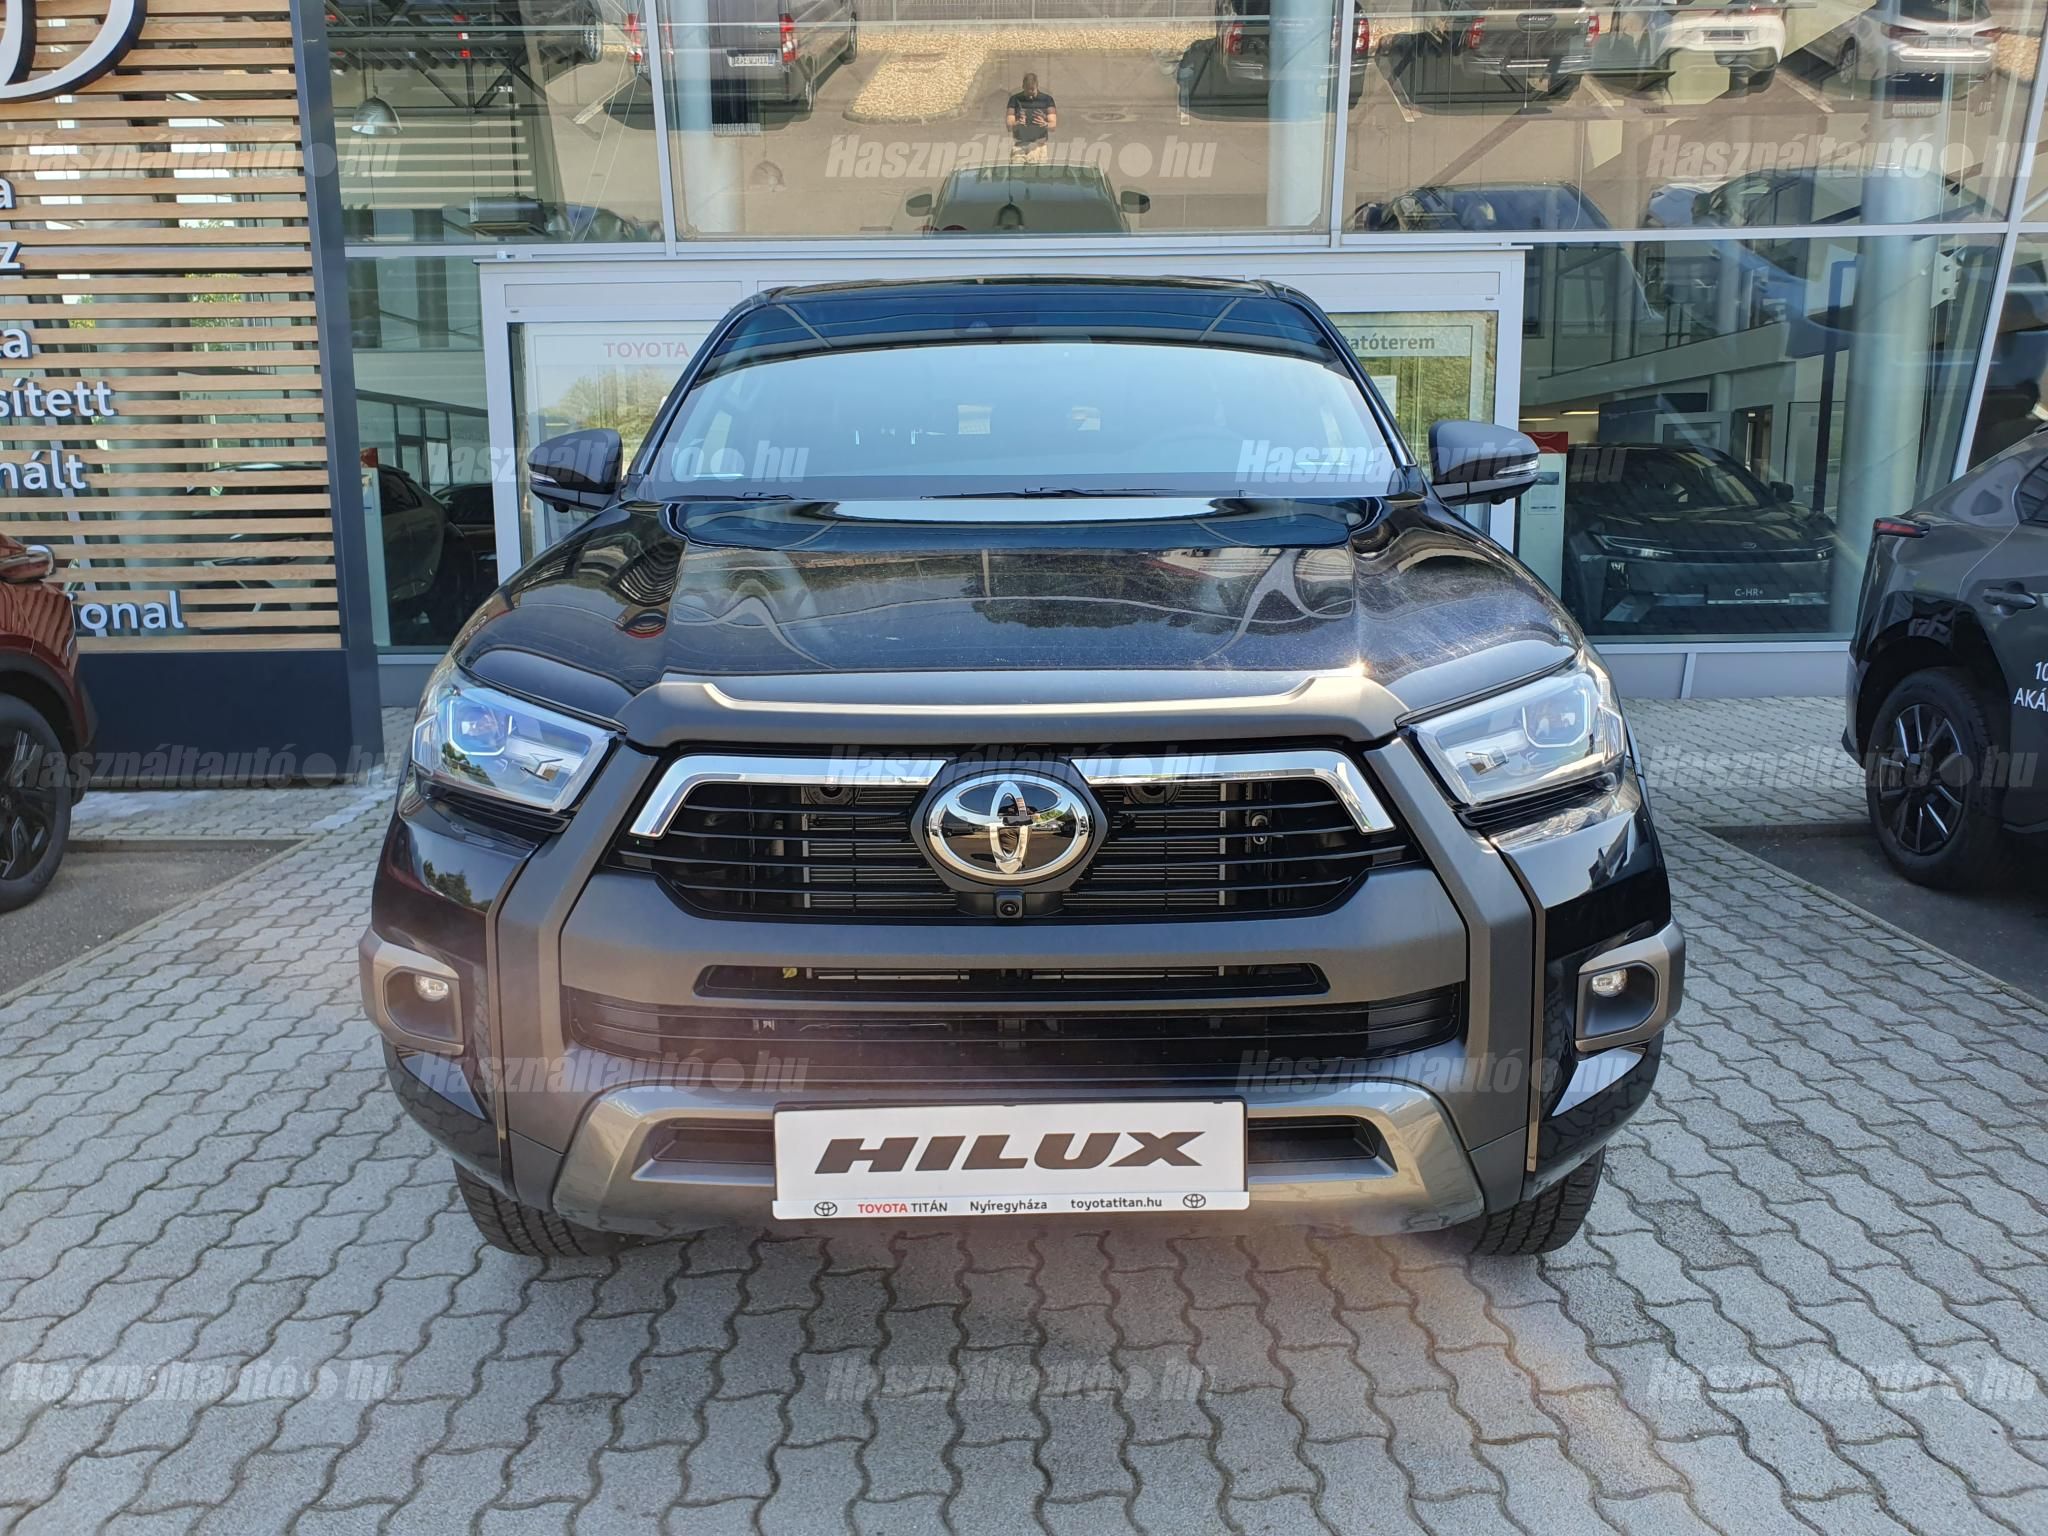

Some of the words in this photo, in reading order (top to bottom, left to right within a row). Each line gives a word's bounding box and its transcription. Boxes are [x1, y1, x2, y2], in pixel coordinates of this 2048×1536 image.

[0, 328, 29, 359] a
[603, 341, 690, 358] TOYOTA
[1344, 332, 1435, 350] atóterem
[66, 590, 185, 630] onal
[2014, 688, 2048, 712] AKÁ
[814, 1131, 1206, 1174] HILUX
[858, 1202, 908, 1214] TOYOTA
[911, 1199, 948, 1213] TITÁN
[970, 1198, 1048, 1214] Nyíregyháza
[1071, 1195, 1163, 1211] toyotatitan.hu
